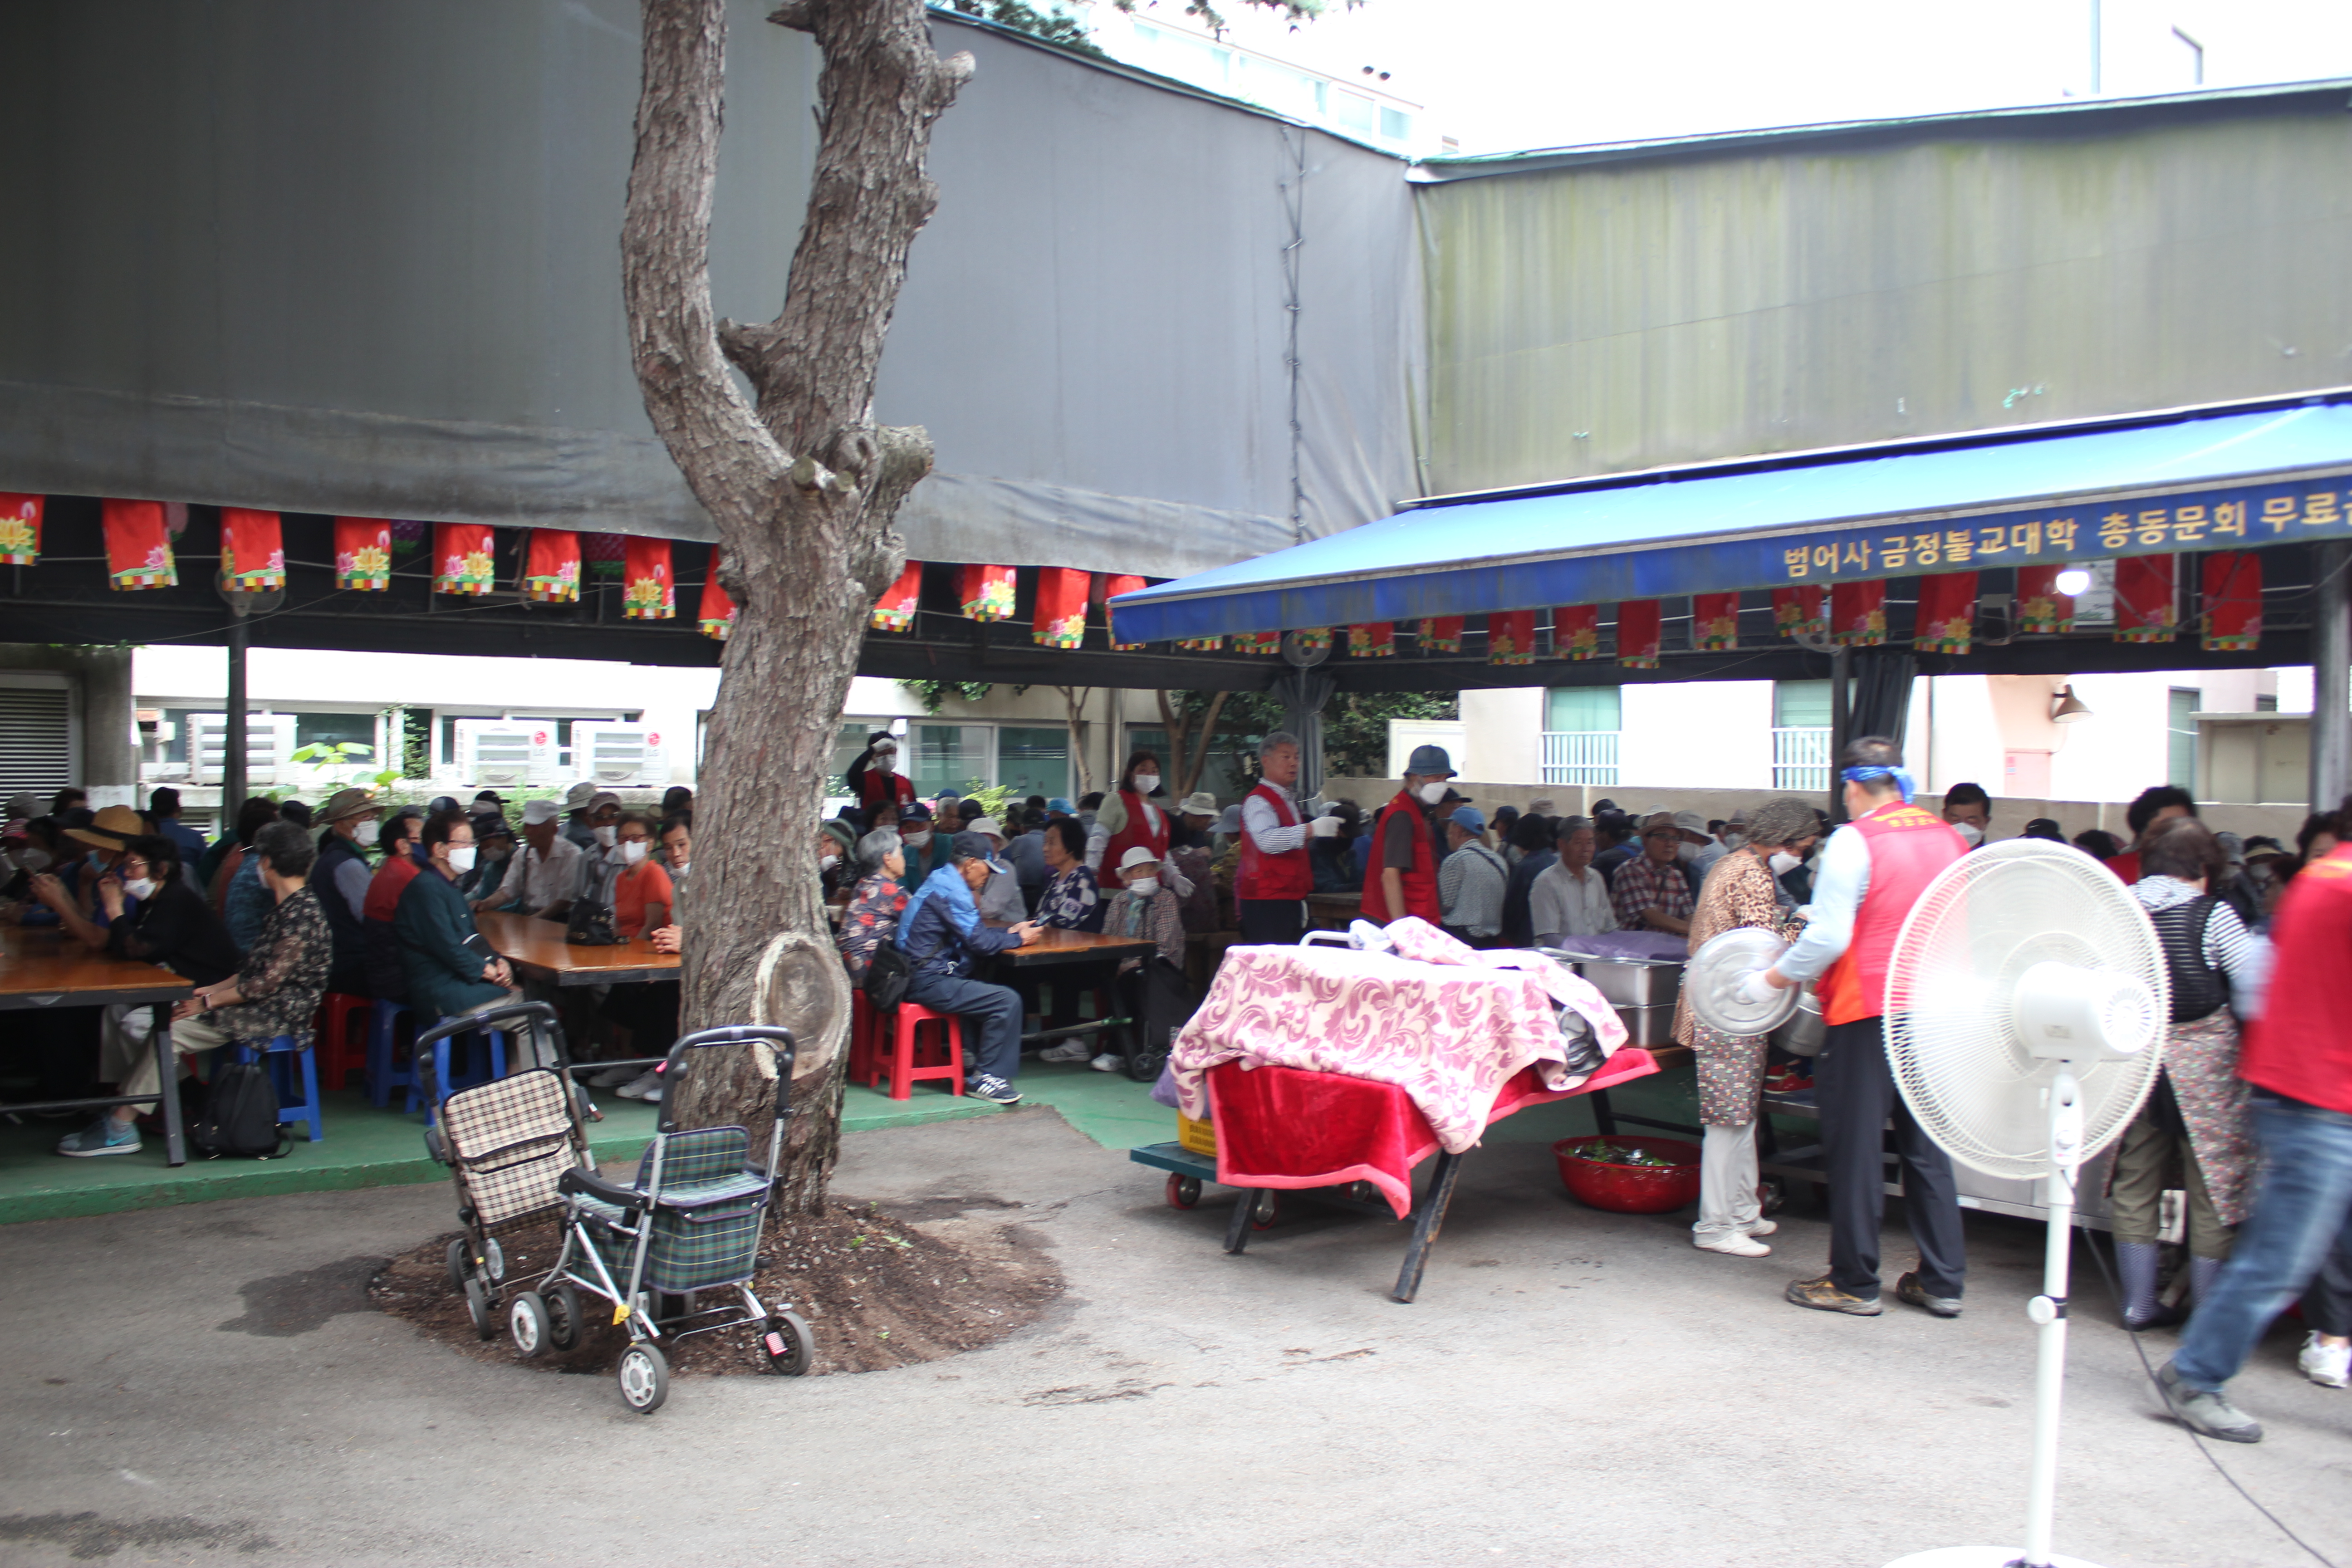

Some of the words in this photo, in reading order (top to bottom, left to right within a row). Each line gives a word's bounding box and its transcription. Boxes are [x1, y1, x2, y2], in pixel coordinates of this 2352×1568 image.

[1784, 539, 1873, 577] 범어사
[1879, 518, 2080, 568] 금정불교대학
[2097, 500, 2246, 549] 총동문회
[533, 748, 547, 756] LG
[647, 749, 661, 758] LG
